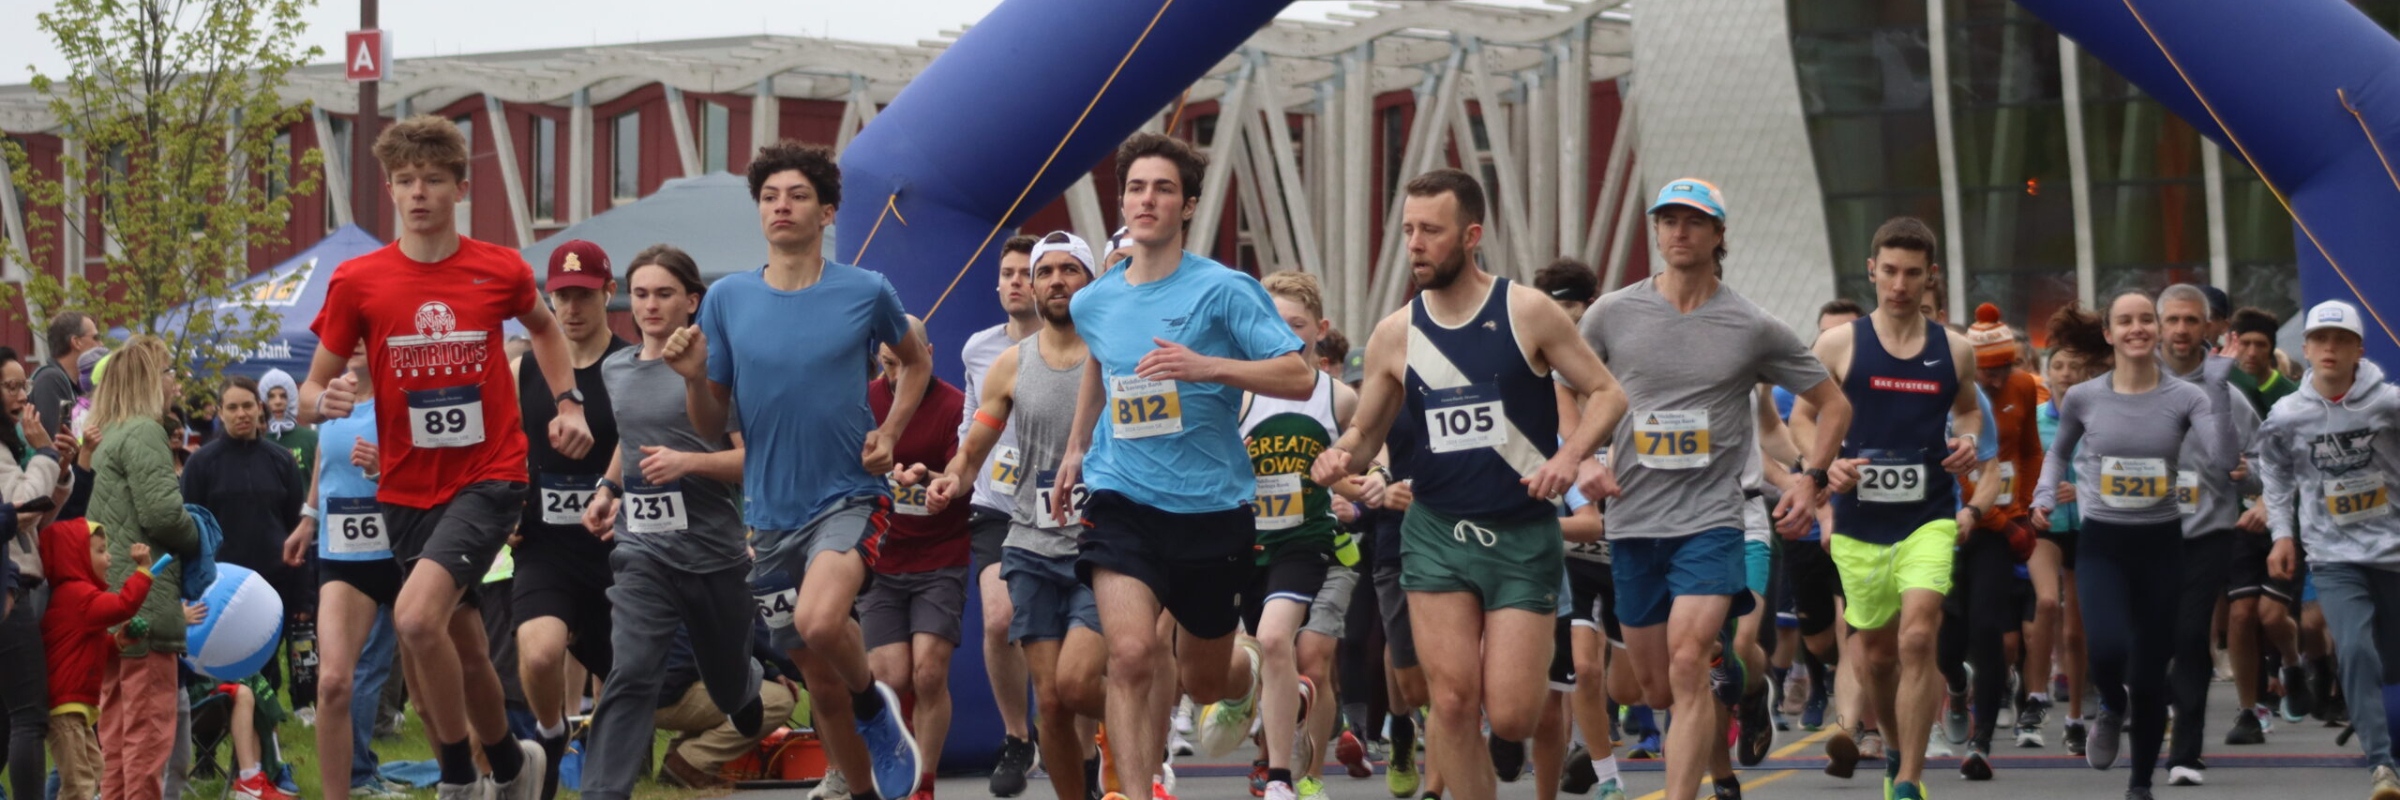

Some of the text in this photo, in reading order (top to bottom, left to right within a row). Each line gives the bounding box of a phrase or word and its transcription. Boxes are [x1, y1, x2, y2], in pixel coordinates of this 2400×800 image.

[353, 39, 375, 72] A
[257, 338, 292, 359] Bank
[389, 341, 488, 368] PATRIOTS
[395, 363, 482, 378] SOCCER
[1874, 379, 1936, 391] BAE SYSTEMS
[424, 408, 467, 435] 89
[1118, 394, 1169, 425] 812
[1434, 405, 1494, 437] 105
[1645, 430, 1697, 456] 716
[1258, 456, 1312, 479] OWEL
[1862, 467, 1918, 490] 209
[2111, 476, 2155, 497] 521
[632, 495, 675, 520] 231
[1041, 486, 1089, 514] 12
[2335, 489, 2377, 515] 817
[343, 516, 379, 540] 66
